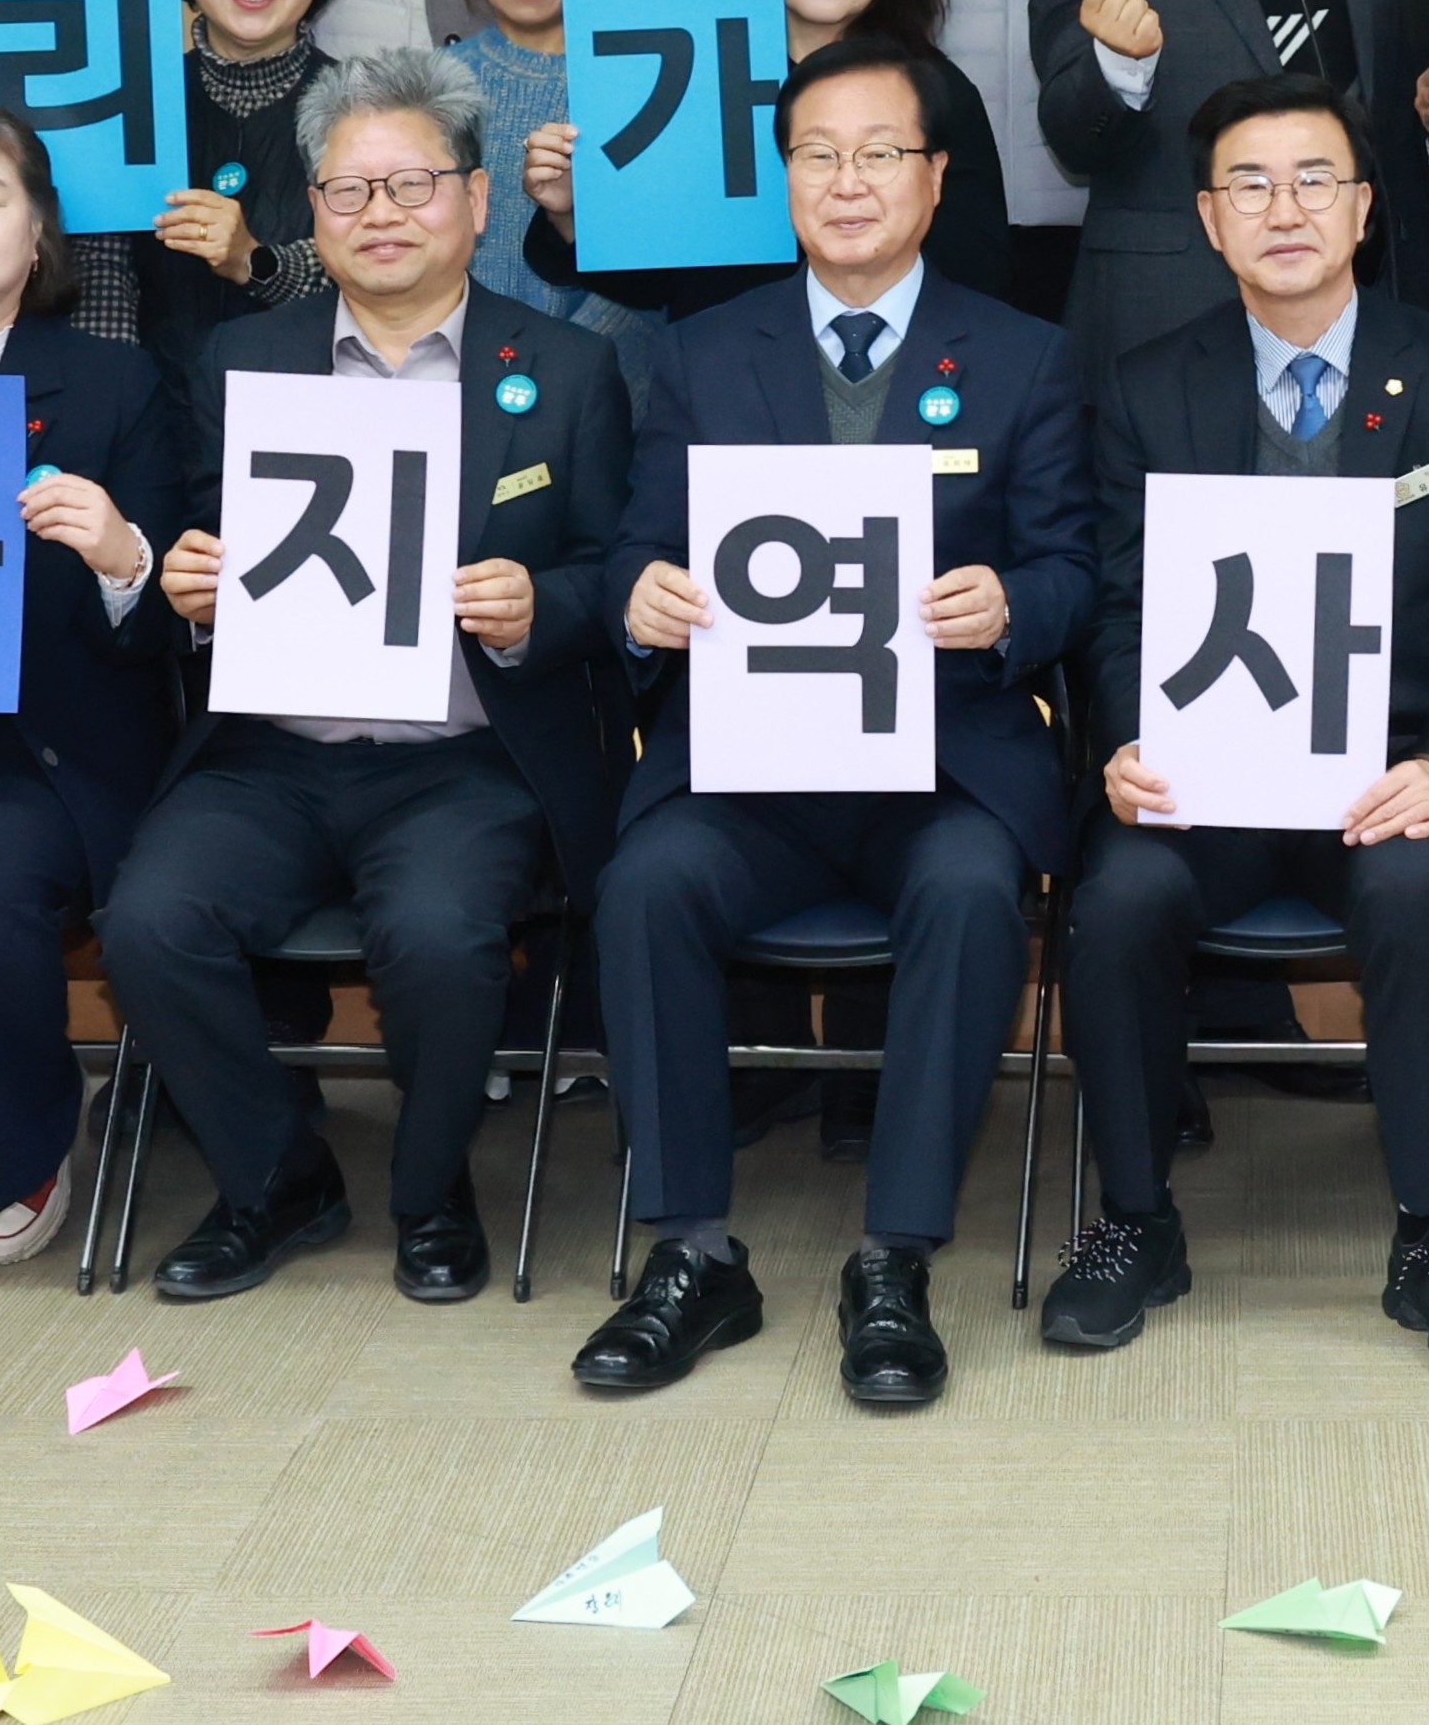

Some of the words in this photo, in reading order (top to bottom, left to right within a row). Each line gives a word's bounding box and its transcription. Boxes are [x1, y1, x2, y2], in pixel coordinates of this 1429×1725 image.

[592, 17, 779, 198] 가
[240, 451, 426, 645] 지
[715, 516, 898, 732] 역
[1161, 554, 1380, 753] 사
